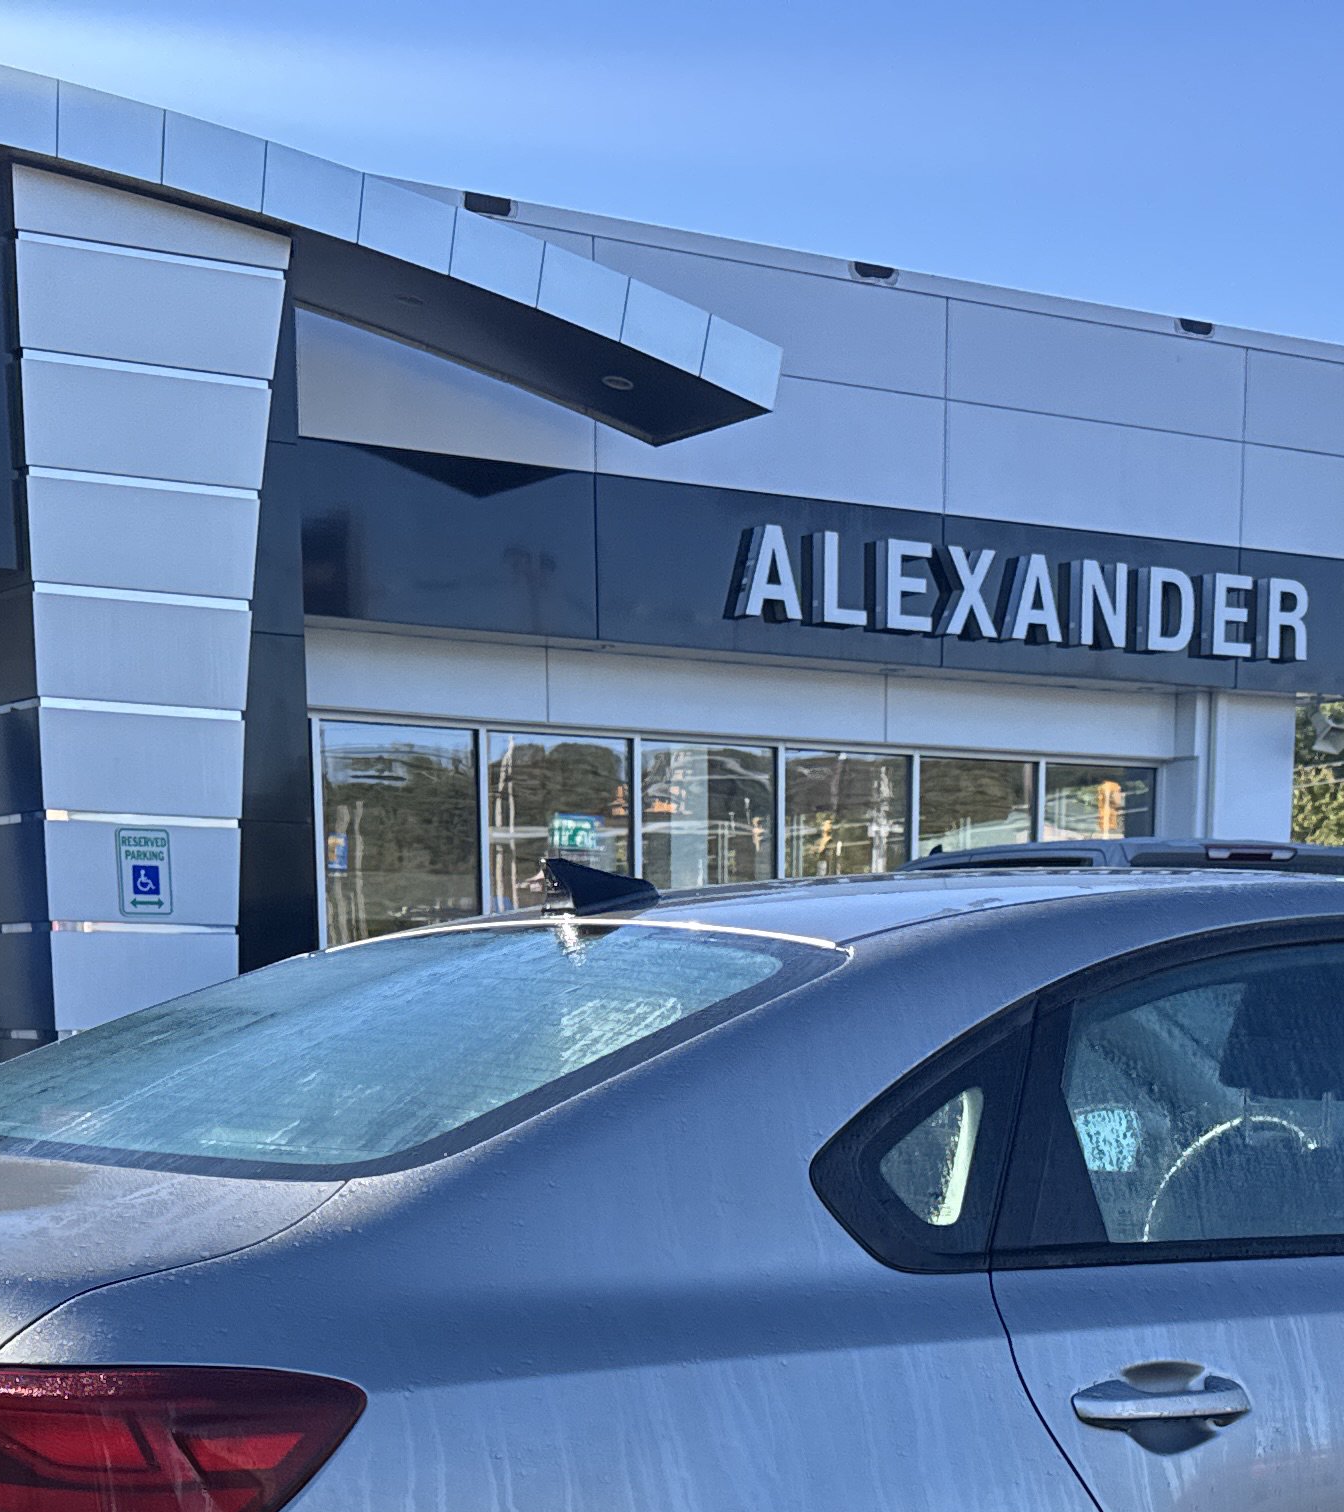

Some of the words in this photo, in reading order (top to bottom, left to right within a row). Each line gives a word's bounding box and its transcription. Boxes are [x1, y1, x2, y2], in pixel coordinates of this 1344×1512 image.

[743, 522, 1310, 662] ALEXANDER
[121, 836, 167, 848] RESERVED
[125, 850, 165, 861] PARKING
